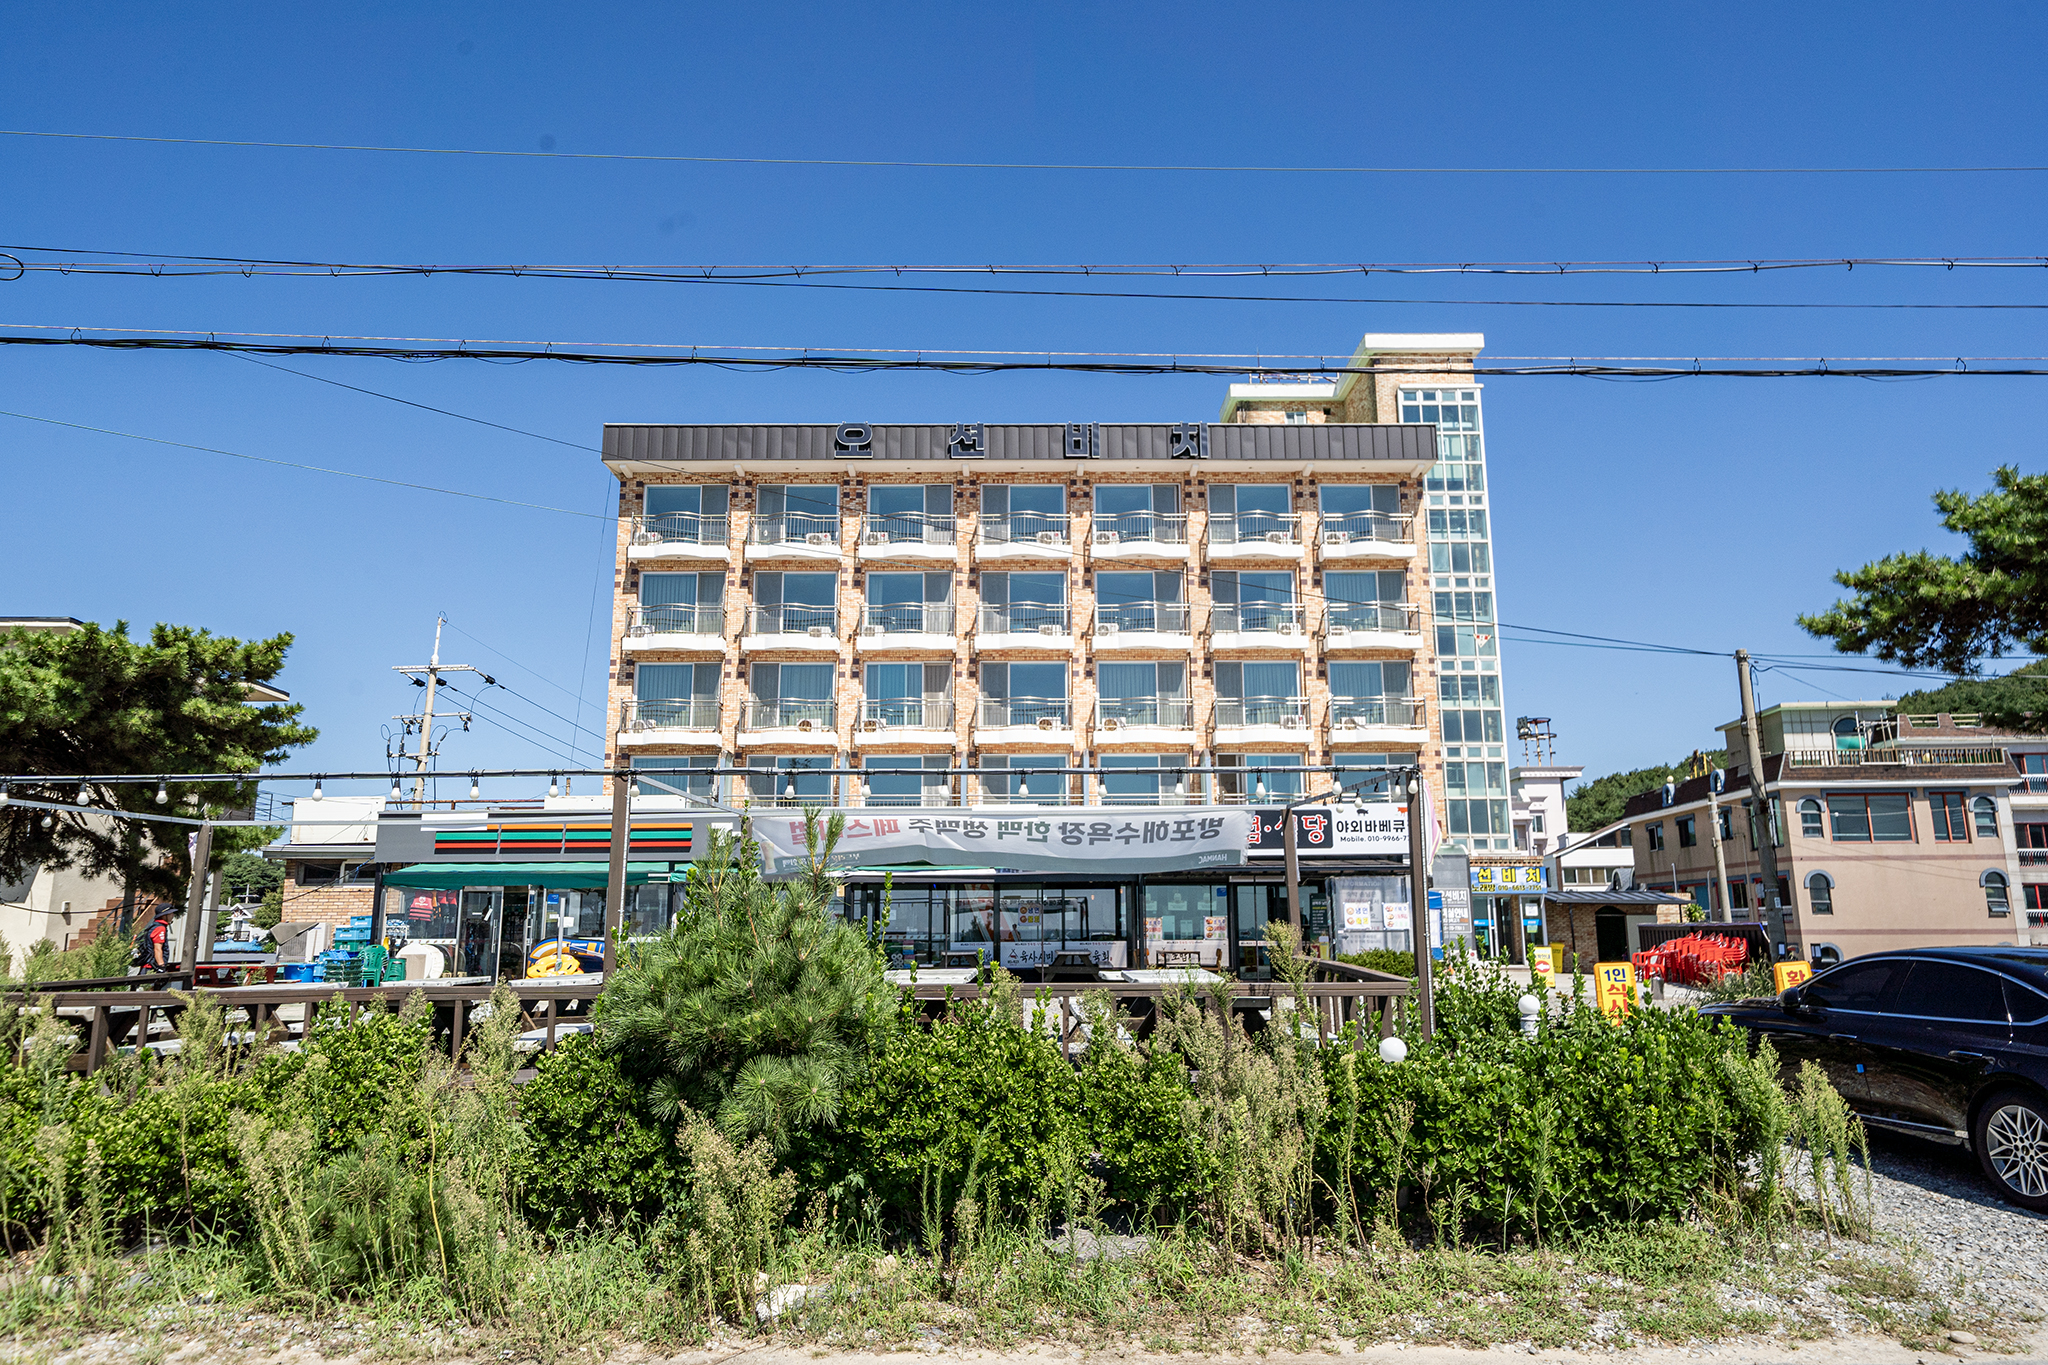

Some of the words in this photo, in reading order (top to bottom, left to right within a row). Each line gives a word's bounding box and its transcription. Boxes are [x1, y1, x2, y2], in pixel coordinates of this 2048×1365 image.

[834, 422, 1209, 459] 오션비치
[1336, 819, 1406, 833] 야외바베큐
[1020, 950, 1054, 963] 육사시미
[1604, 968, 1626, 982] 1인
